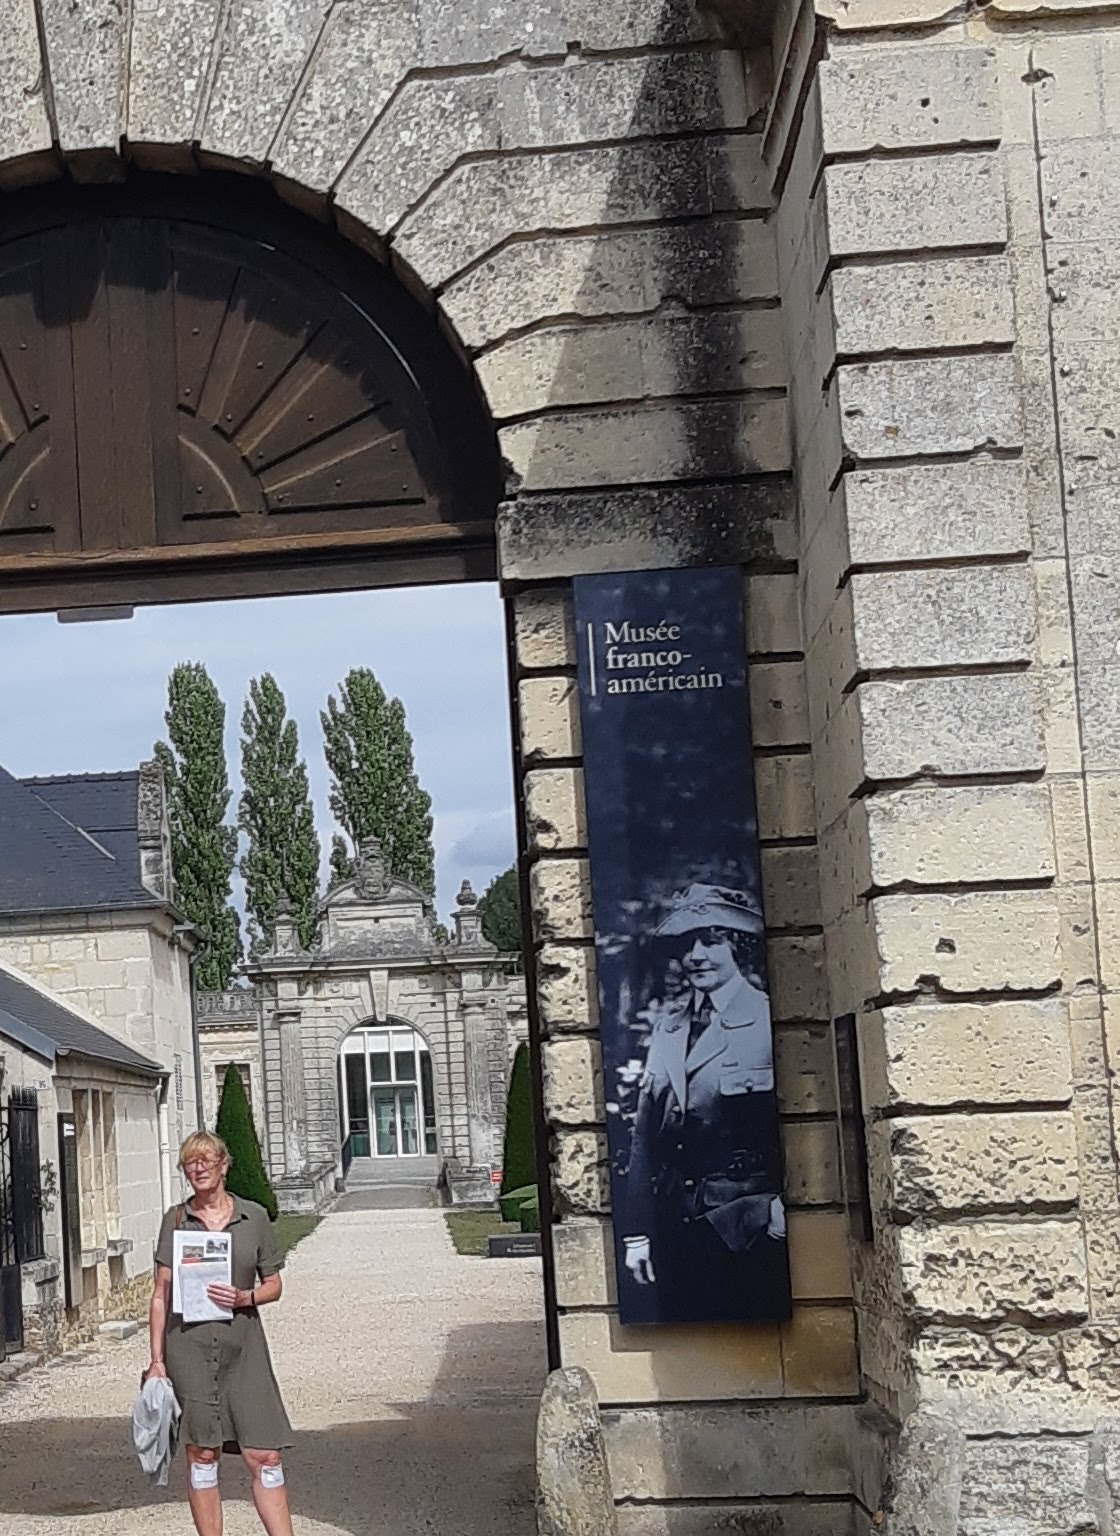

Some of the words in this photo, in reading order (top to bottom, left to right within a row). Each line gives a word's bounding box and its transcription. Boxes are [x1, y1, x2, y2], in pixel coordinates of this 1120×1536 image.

[604, 620, 680, 644] Musée
[606, 646, 692, 669] franco-
[608, 667, 723, 693] américain
